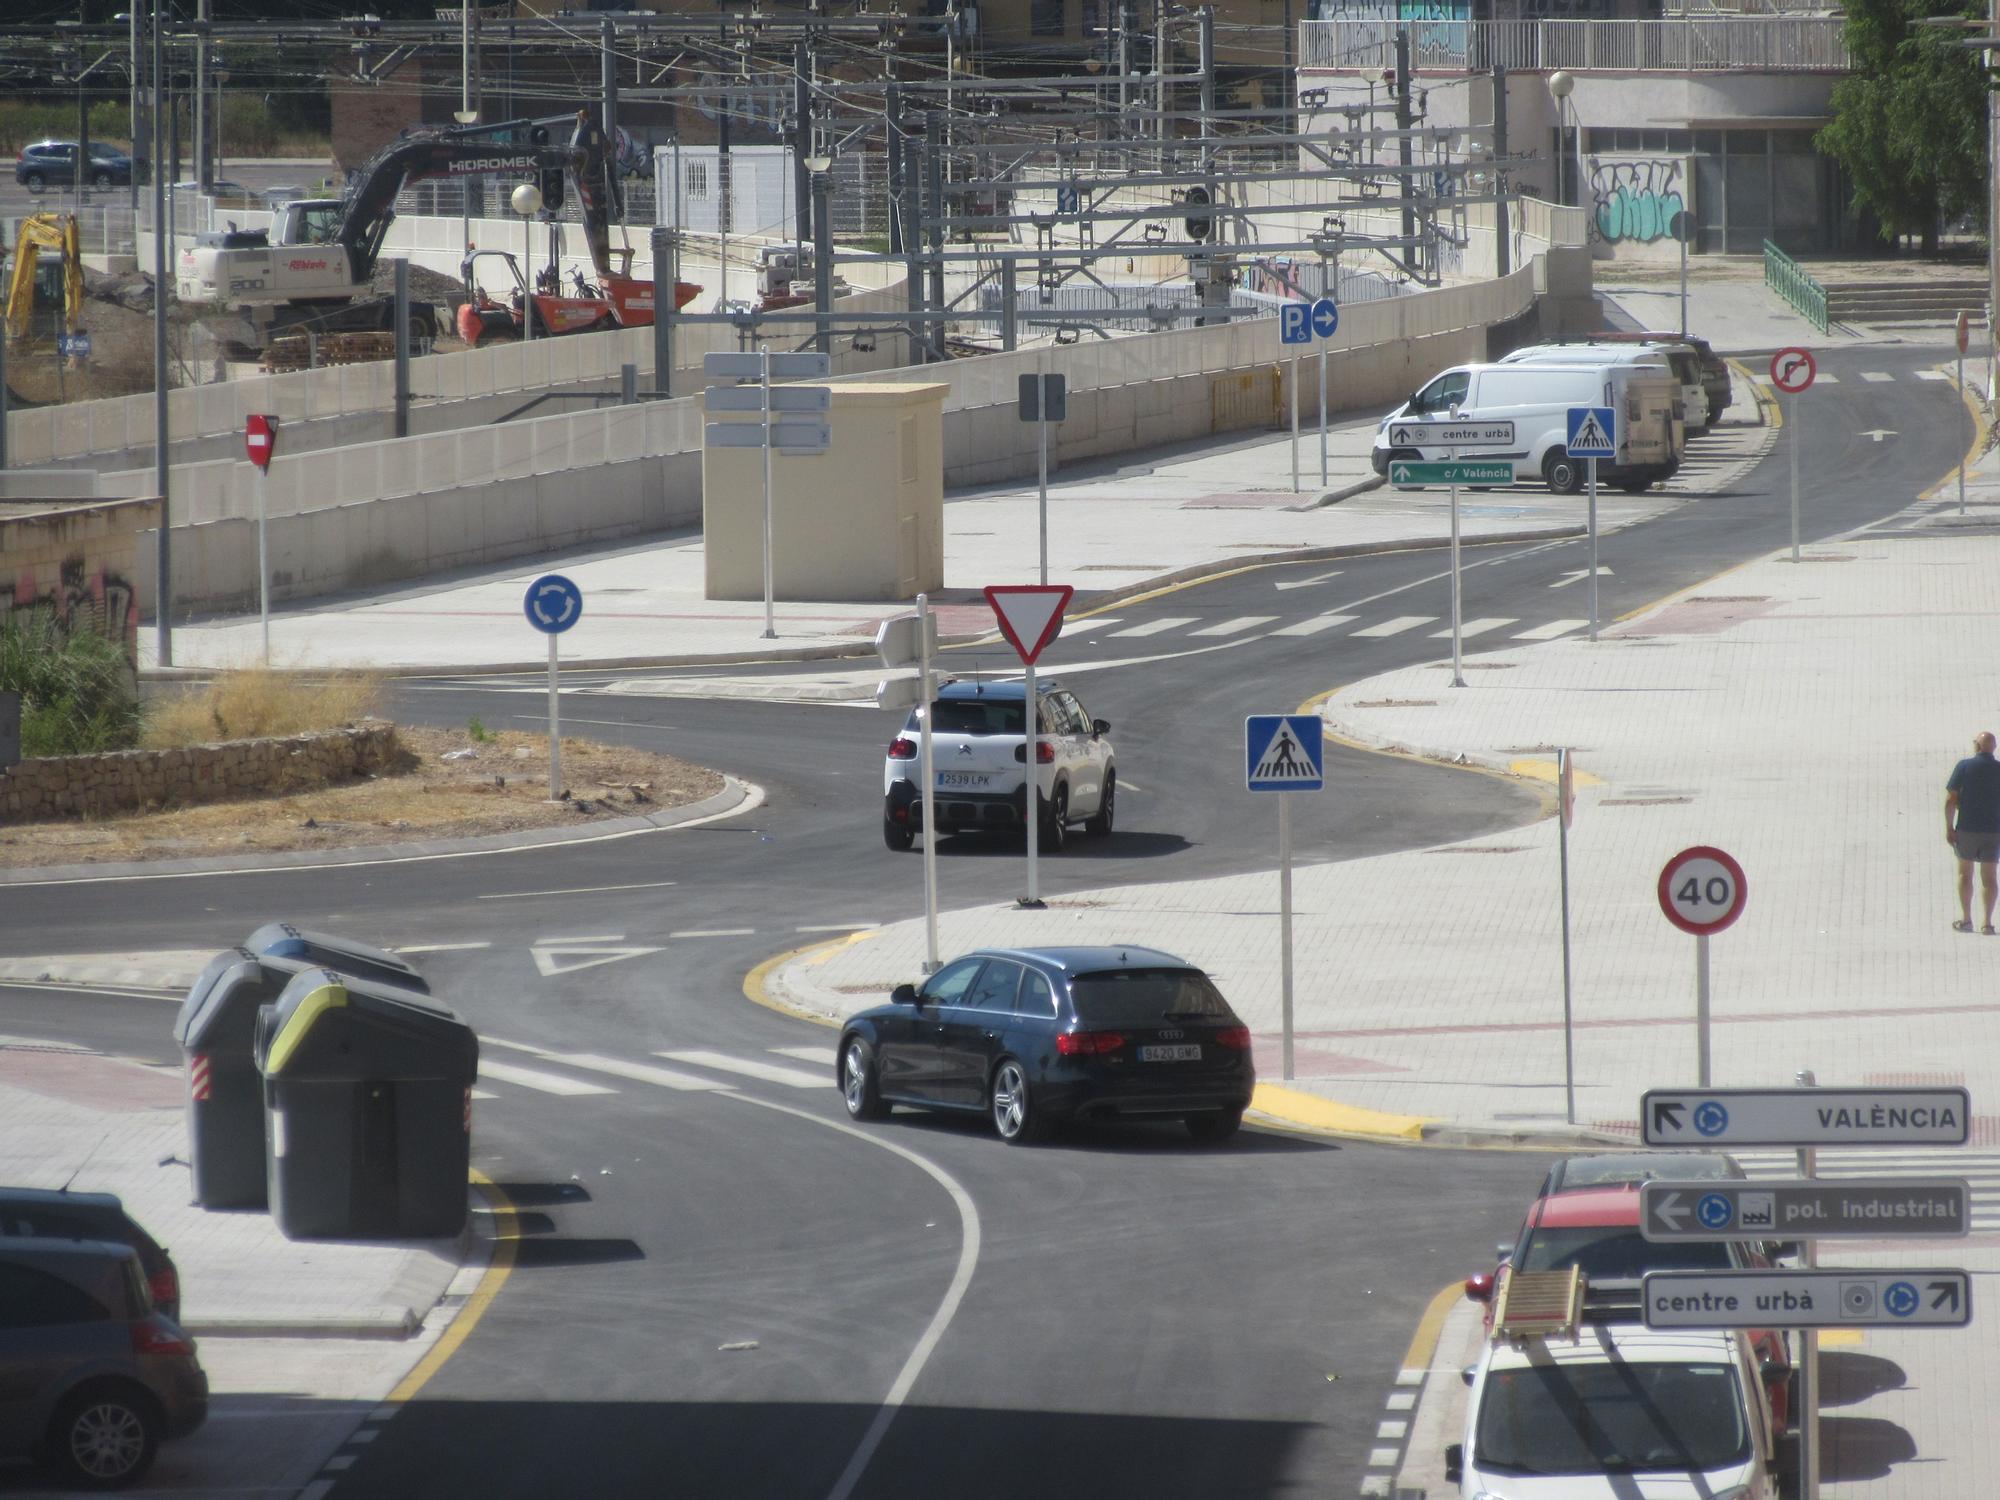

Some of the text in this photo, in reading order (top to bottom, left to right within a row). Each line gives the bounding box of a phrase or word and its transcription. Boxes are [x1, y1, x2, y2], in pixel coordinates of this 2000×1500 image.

[1285, 306, 1304, 338] P
[1442, 429, 1478, 439] centre
[1444, 468, 1458, 478] c/
[945, 775, 990, 785] 2539 LPK
[1677, 877, 1729, 906] 40
[1145, 1048, 1174, 1060] 9420
[1817, 1103, 1957, 1129] VALÈNCIA
[1786, 1199, 1956, 1221] pol. industrial
[1656, 1290, 1814, 1312] centre urbà
